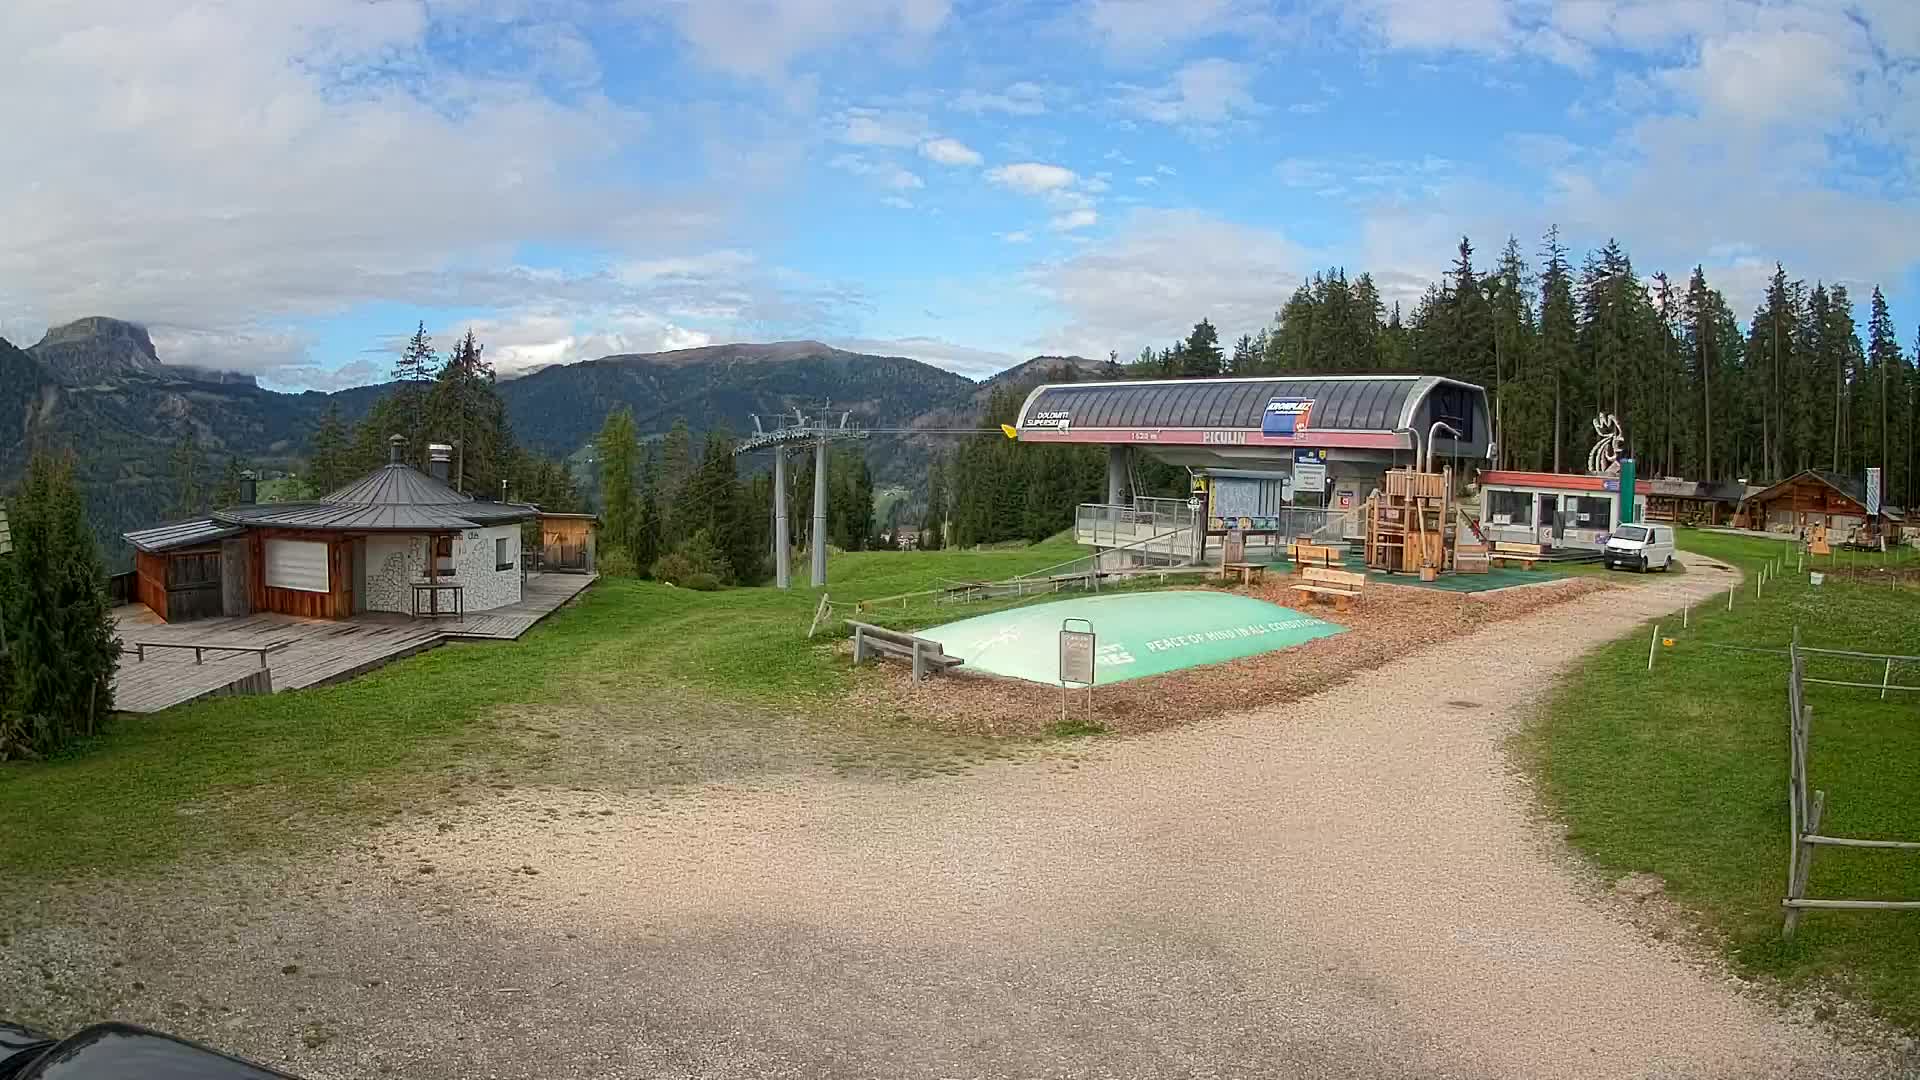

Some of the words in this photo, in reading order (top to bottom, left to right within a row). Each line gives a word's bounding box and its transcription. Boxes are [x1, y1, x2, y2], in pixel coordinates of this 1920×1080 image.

[1203, 431, 1246, 445] PICULIN
[1145, 636, 1189, 653] PEACE
[1188, 632, 1205, 645] OF
[1205, 629, 1236, 641] MIND
